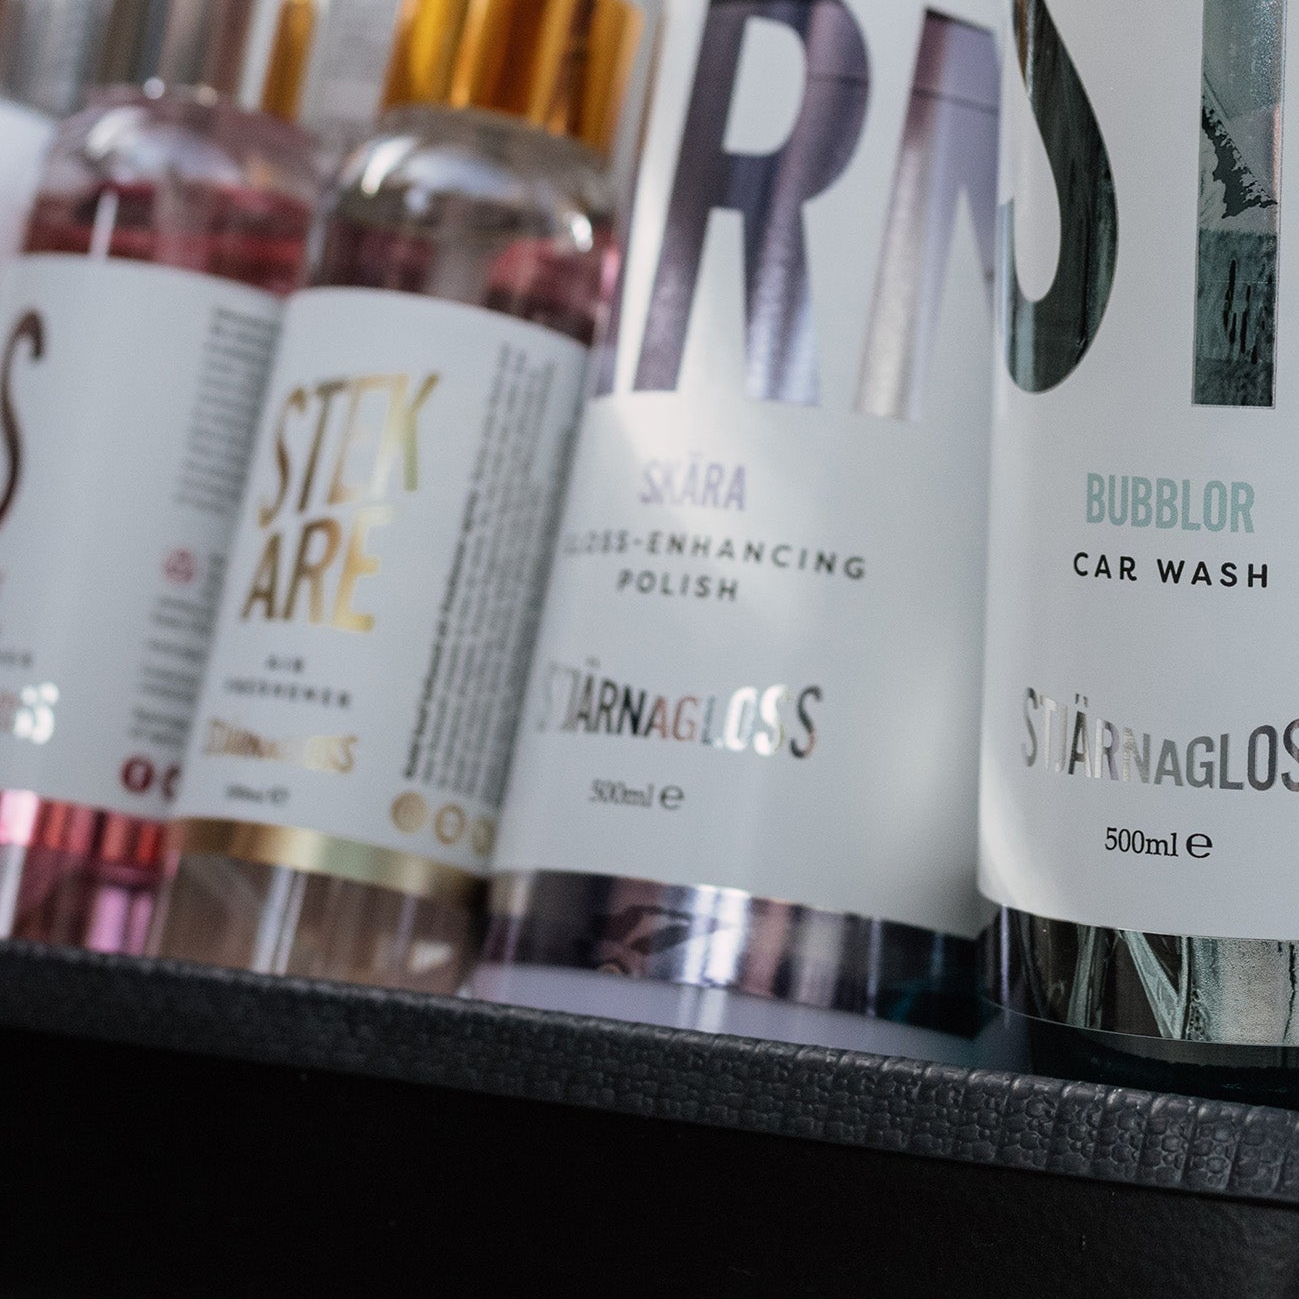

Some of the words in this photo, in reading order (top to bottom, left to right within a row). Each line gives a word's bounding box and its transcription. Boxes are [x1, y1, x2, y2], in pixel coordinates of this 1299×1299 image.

[256, 370, 440, 531] STEK
[1085, 472, 1255, 533] BUBBLOR
[239, 505, 393, 633] ARE
[616, 568, 739, 601] POLISH
[1073, 552, 1138, 582] CAR
[1157, 558, 1269, 588] WASH
[1104, 827, 1179, 857] 500ml
